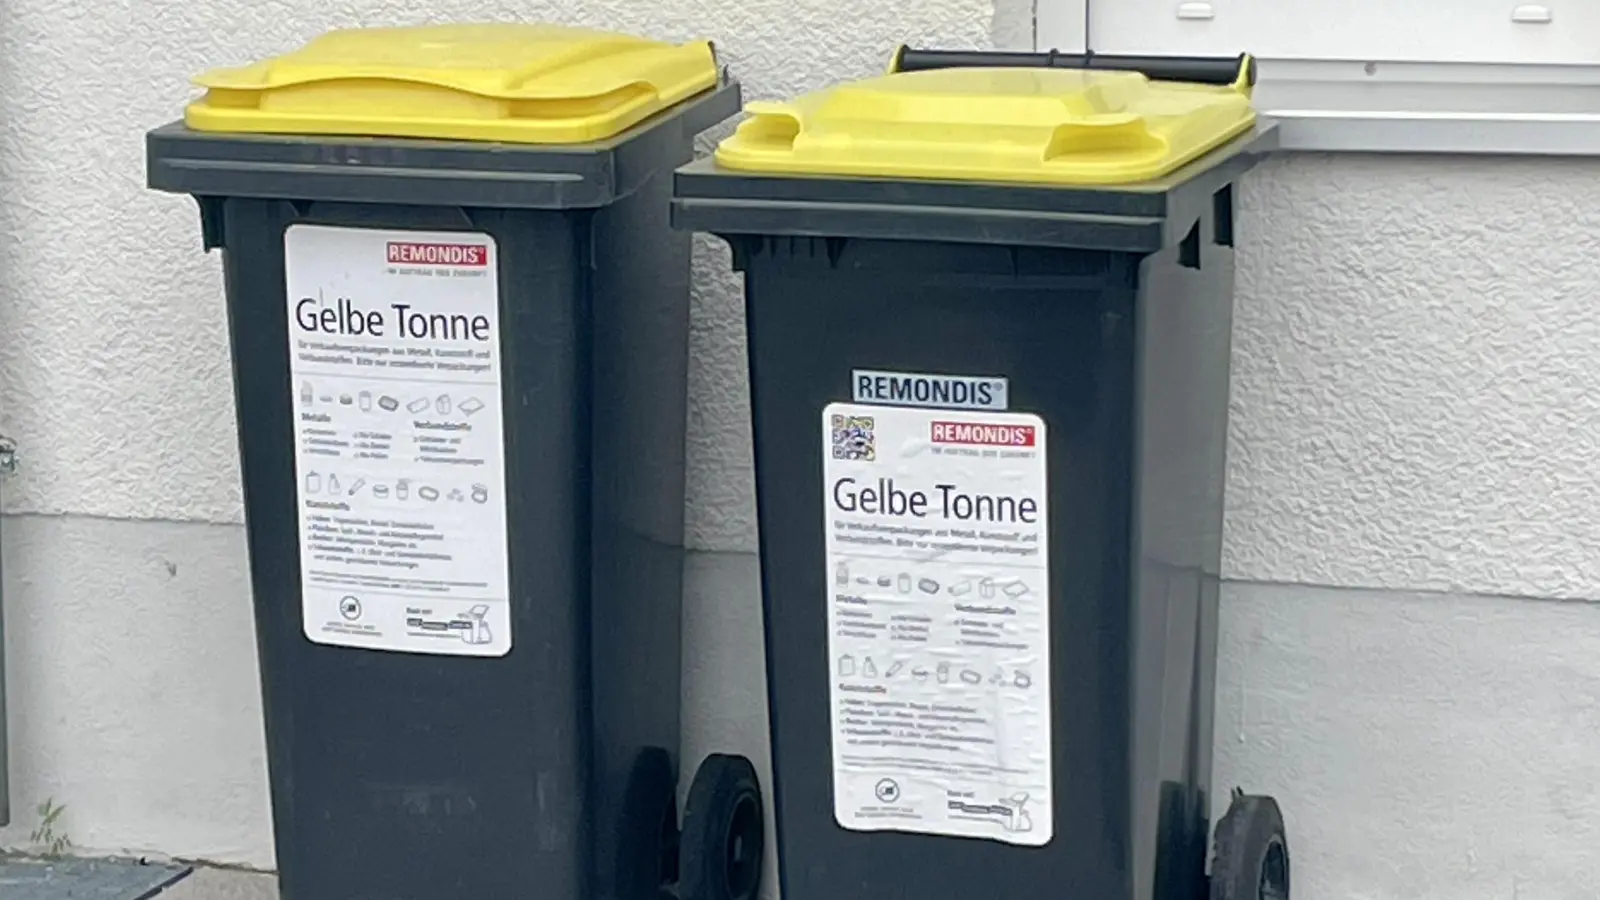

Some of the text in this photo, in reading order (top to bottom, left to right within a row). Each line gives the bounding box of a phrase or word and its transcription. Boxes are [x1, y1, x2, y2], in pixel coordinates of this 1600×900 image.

[296, 297, 490, 342] Gelbe Tonne
[833, 477, 1038, 524] Gelbe Tonne
